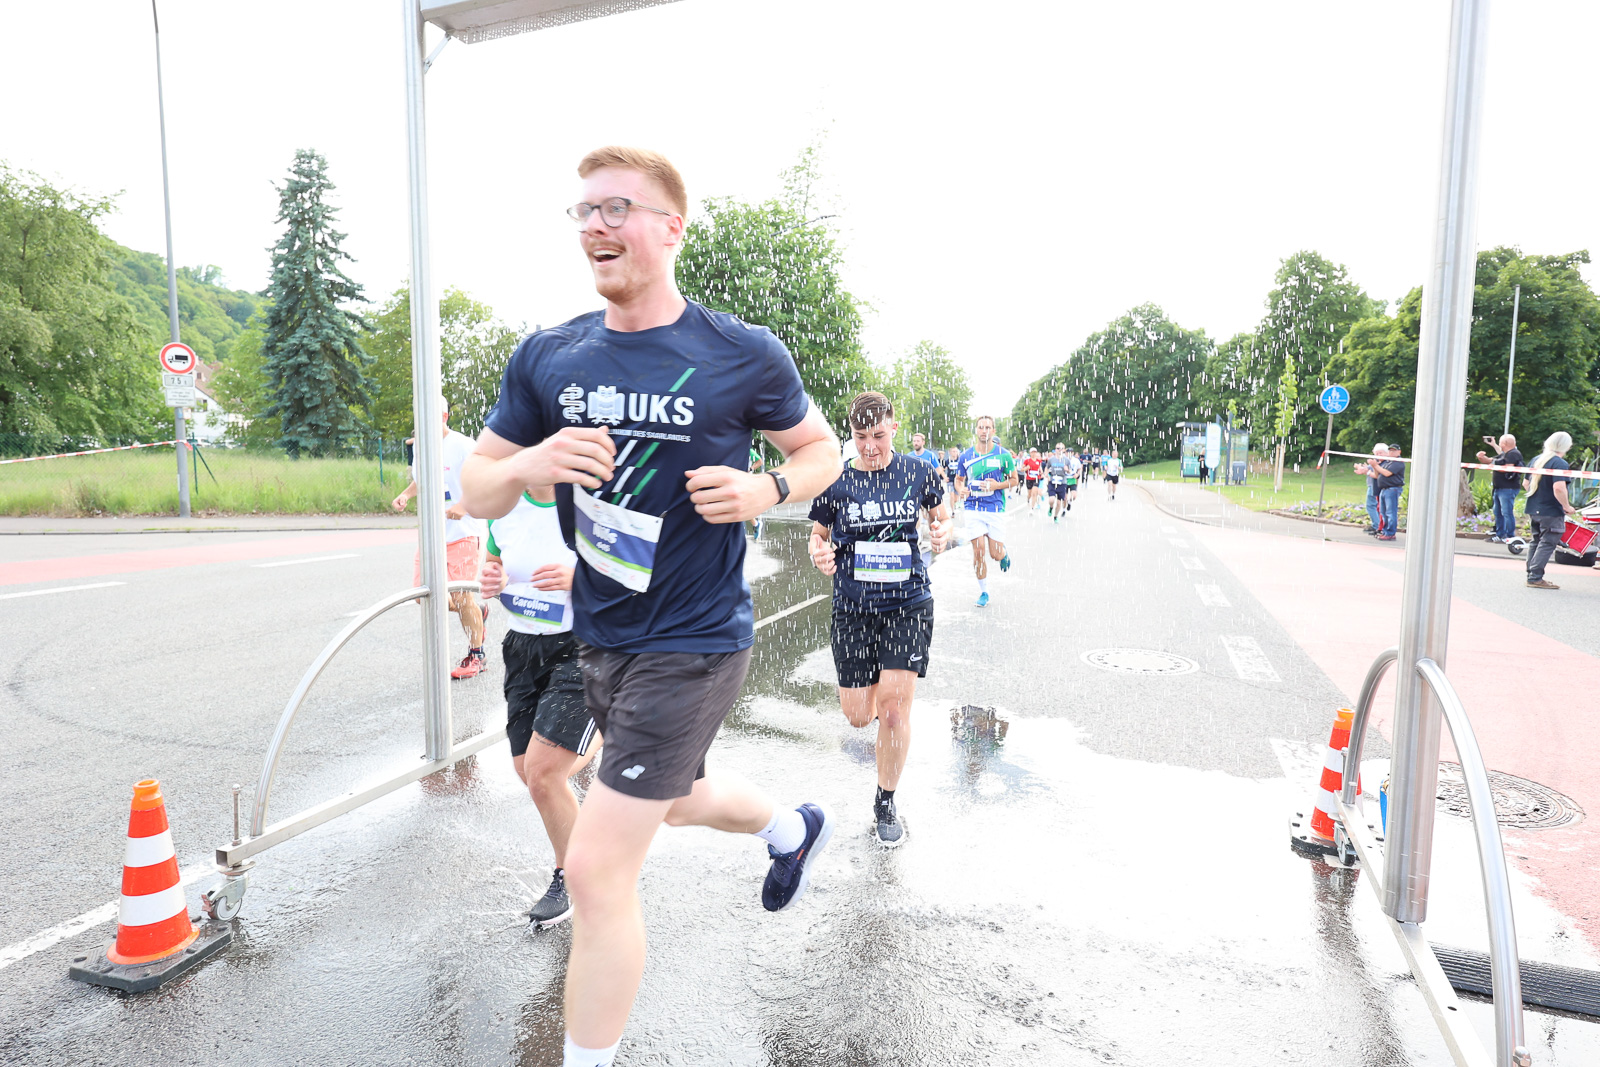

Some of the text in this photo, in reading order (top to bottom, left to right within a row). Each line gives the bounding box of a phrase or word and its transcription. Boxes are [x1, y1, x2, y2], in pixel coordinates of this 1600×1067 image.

[628, 392, 695, 426] UKS
[883, 499, 915, 517] UKS
[865, 554, 902, 564] Natascha
[512, 595, 550, 612] Caroline
